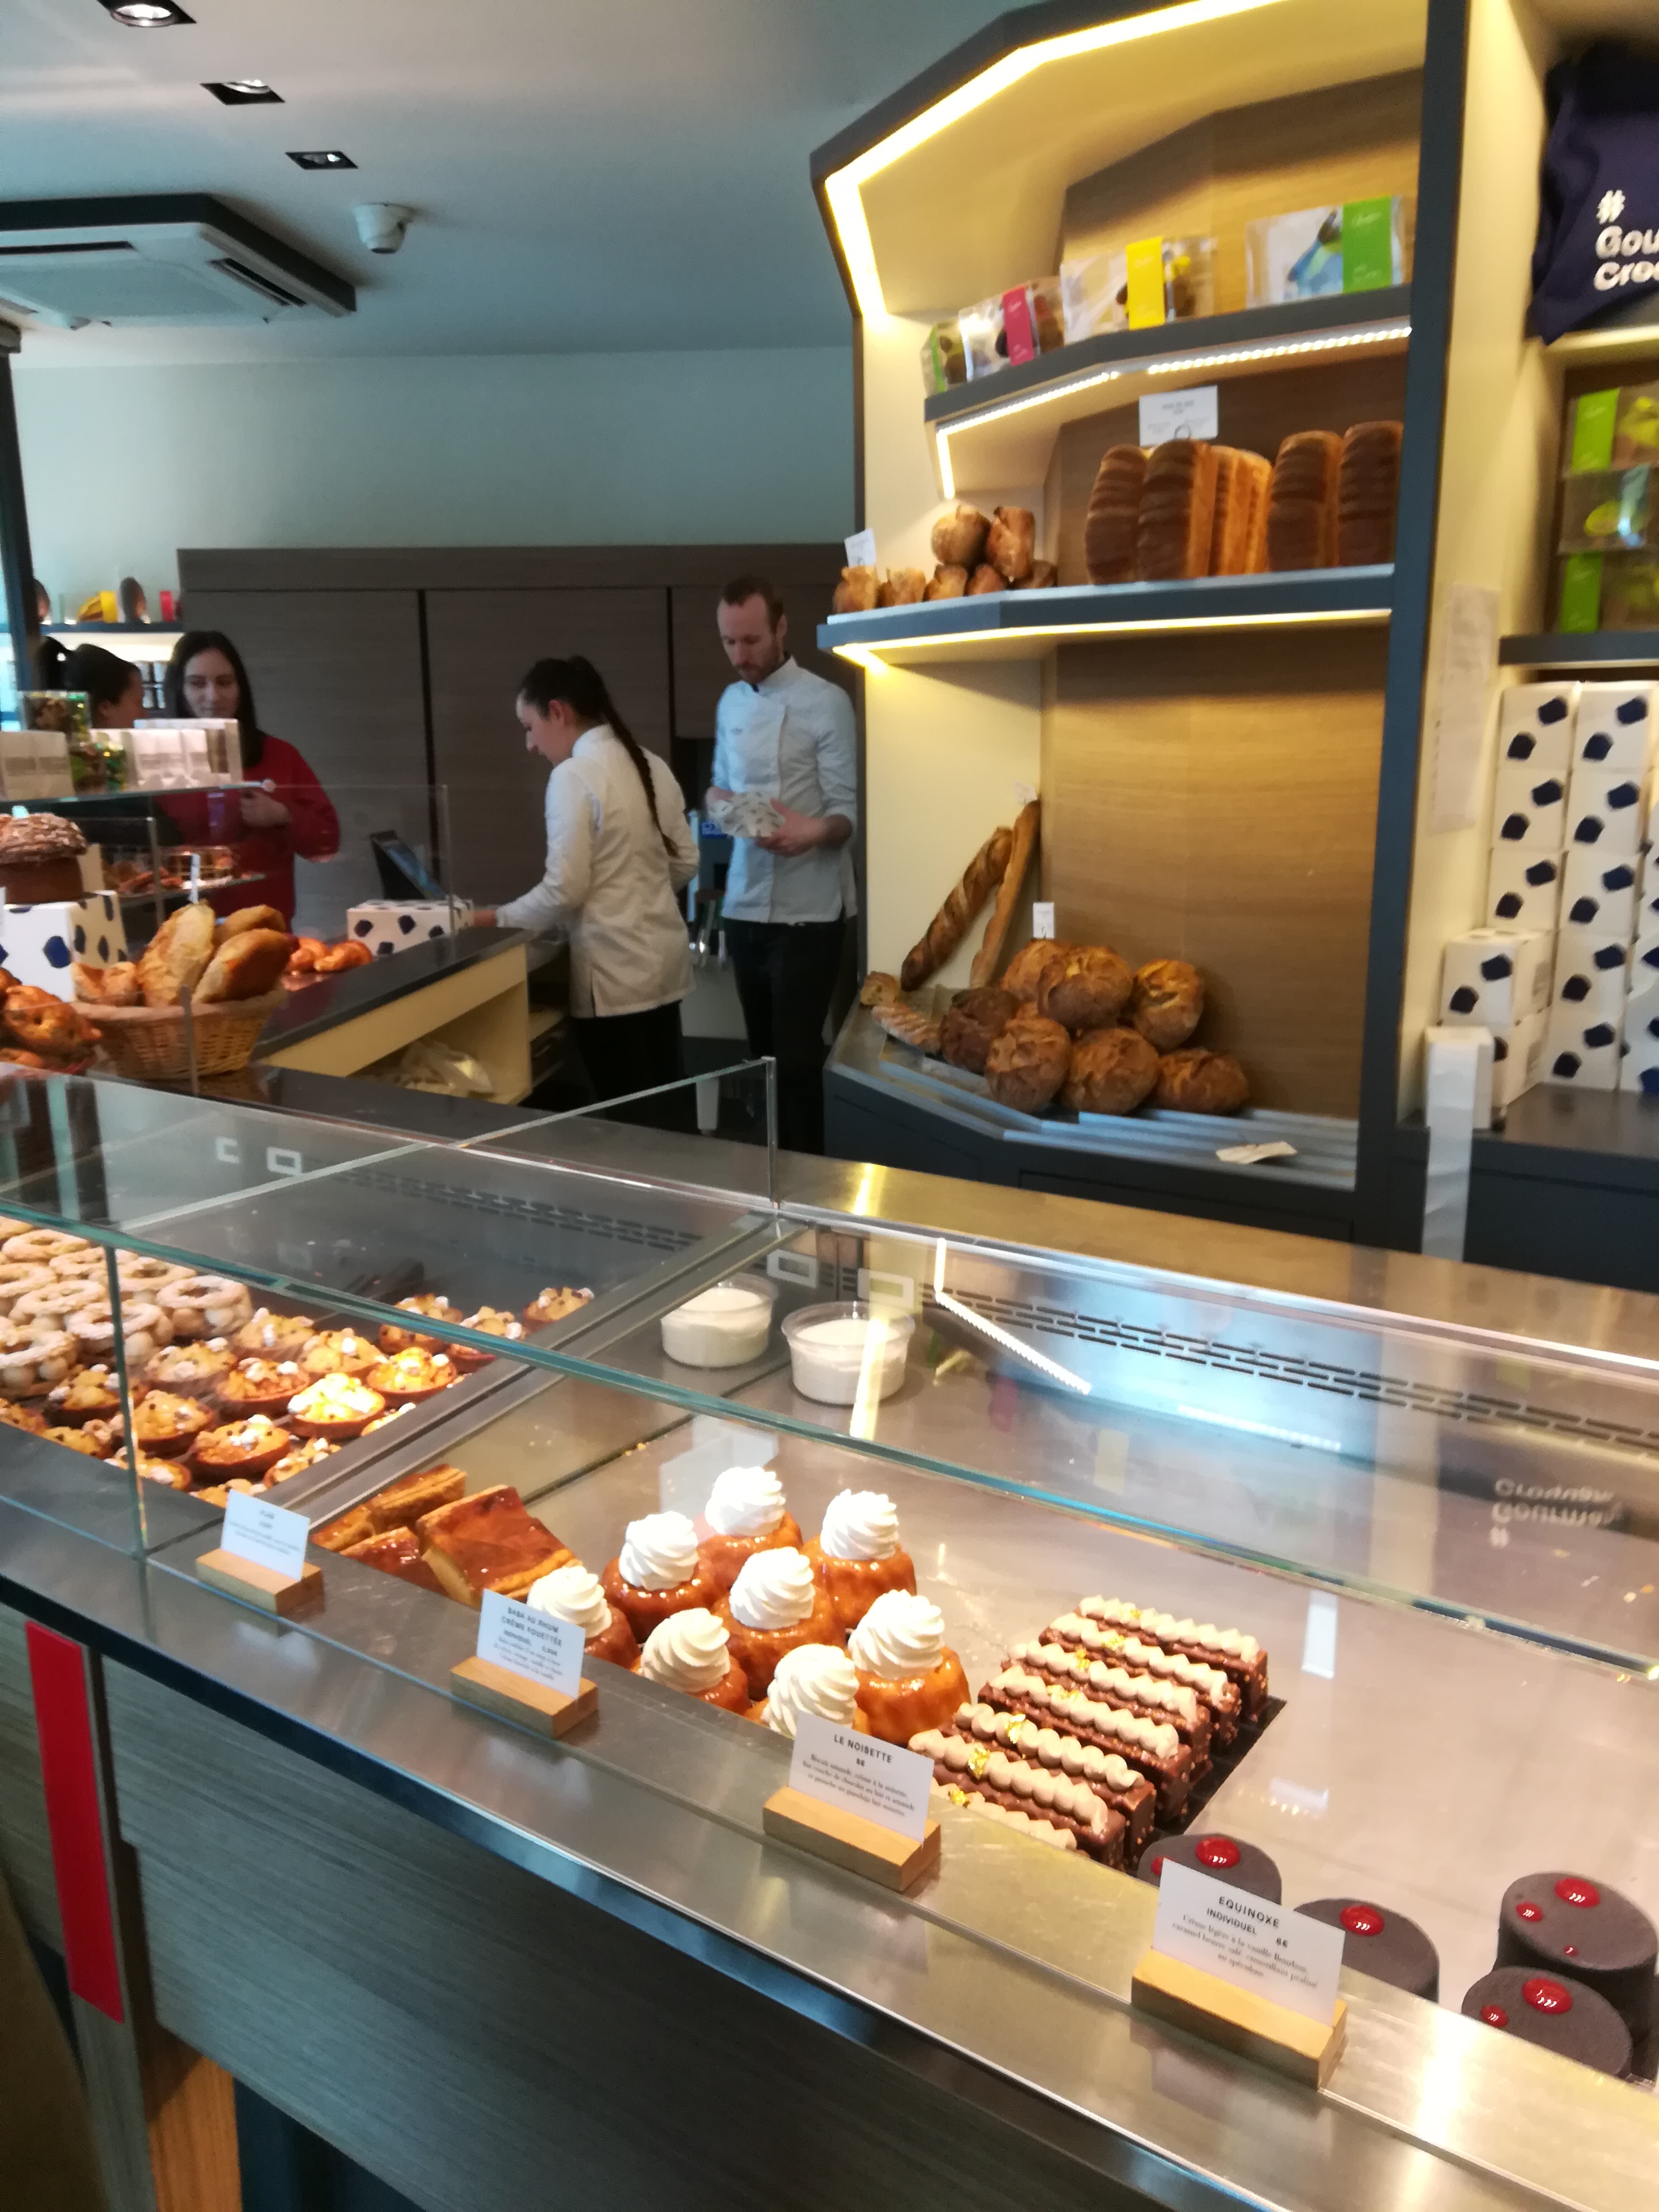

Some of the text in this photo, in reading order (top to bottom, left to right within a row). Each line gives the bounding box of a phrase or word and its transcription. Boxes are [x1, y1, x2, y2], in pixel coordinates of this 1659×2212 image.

[834, 1734, 893, 1764] LE NOISETTE
[1207, 1908, 1258, 1935] INDIVIDUEL
[1218, 1895, 1280, 1929] EQUINOXE
